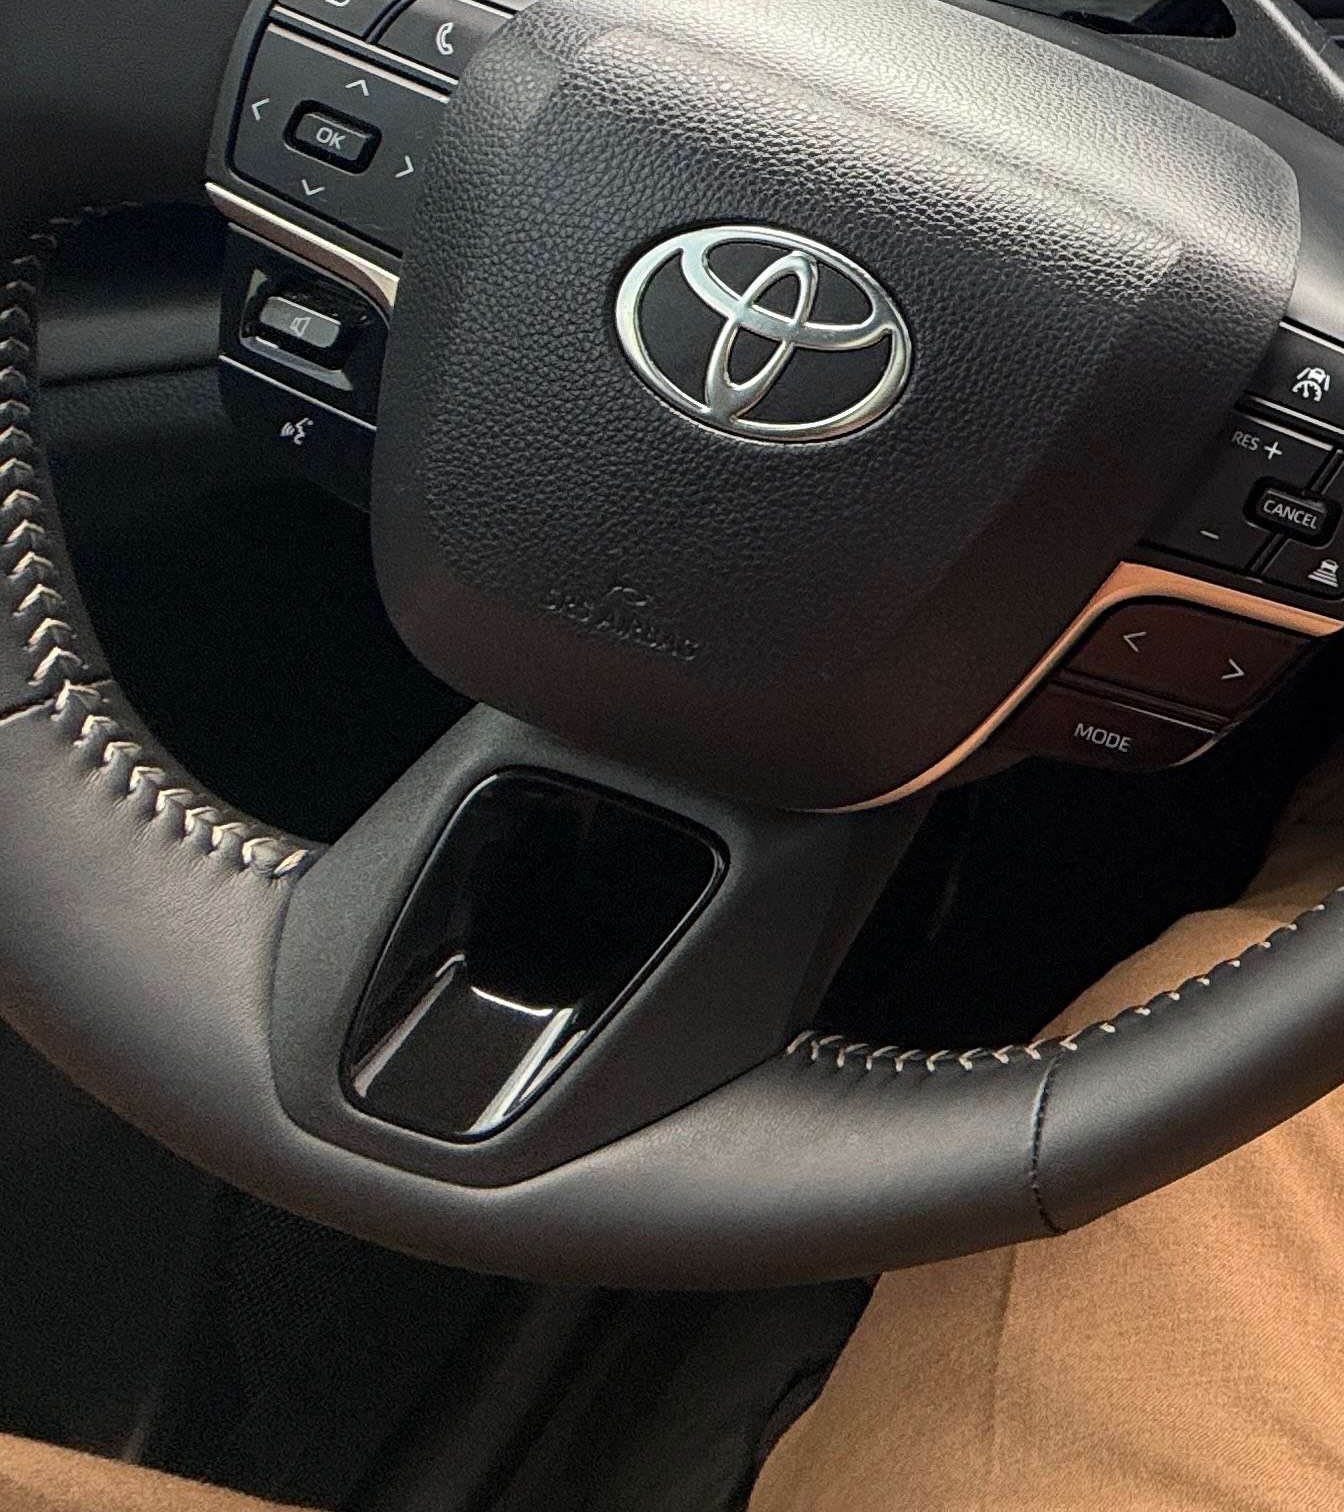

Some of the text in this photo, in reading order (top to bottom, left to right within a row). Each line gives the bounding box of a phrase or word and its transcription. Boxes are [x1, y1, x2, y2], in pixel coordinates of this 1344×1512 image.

[315, 125, 347, 150] OK
[1231, 430, 1258, 452] RES
[1262, 498, 1319, 531] CANCEL
[1074, 722, 1132, 753] MODE
